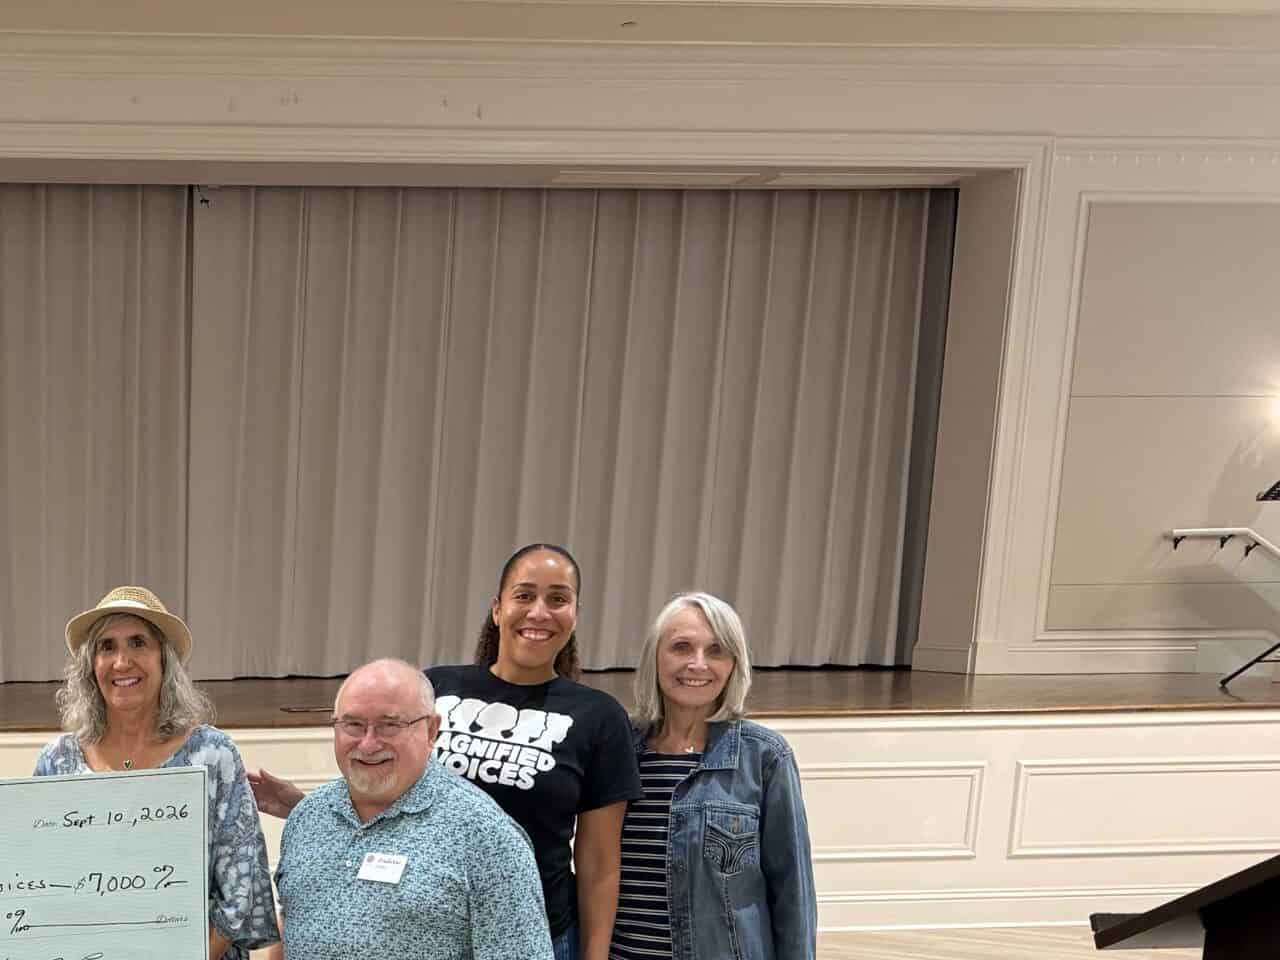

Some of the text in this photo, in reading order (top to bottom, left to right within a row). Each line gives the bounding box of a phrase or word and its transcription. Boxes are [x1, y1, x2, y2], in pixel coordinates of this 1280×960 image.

[433, 732, 556, 772] AGNIFIED
[63, 811, 95, 828] Sept
[140, 804, 188, 821] 2026
